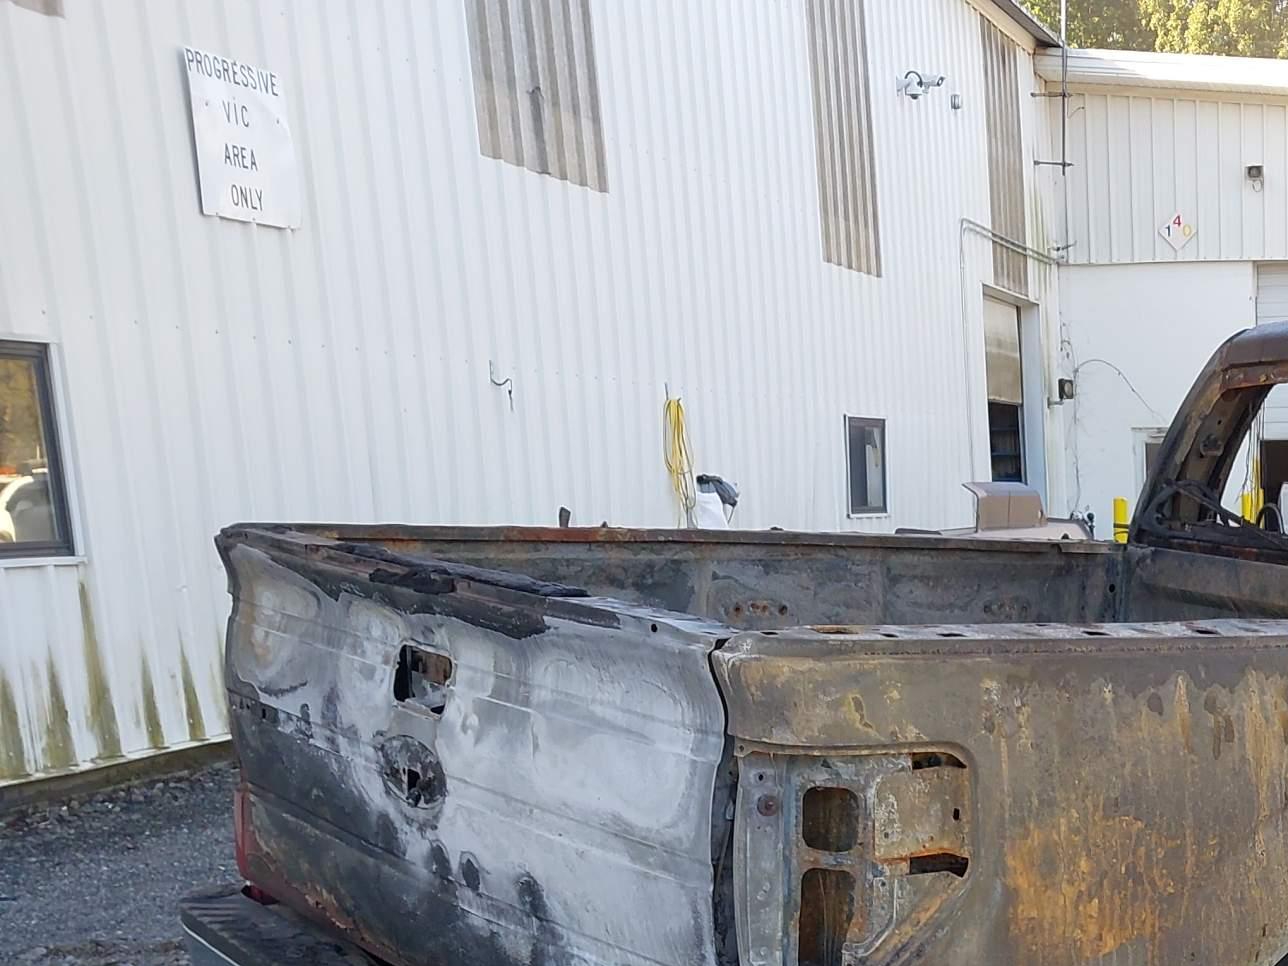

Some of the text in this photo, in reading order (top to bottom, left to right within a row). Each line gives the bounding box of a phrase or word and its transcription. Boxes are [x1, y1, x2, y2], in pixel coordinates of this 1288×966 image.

[184, 48, 279, 97] PROGRESSIVE
[222, 99, 250, 128] VIC
[224, 143, 258, 171] AREA
[230, 184, 263, 211] ONLY
[1165, 224, 1171, 237] 1
[1173, 214, 1182, 227] 4
[1183, 224, 1192, 237] 0
